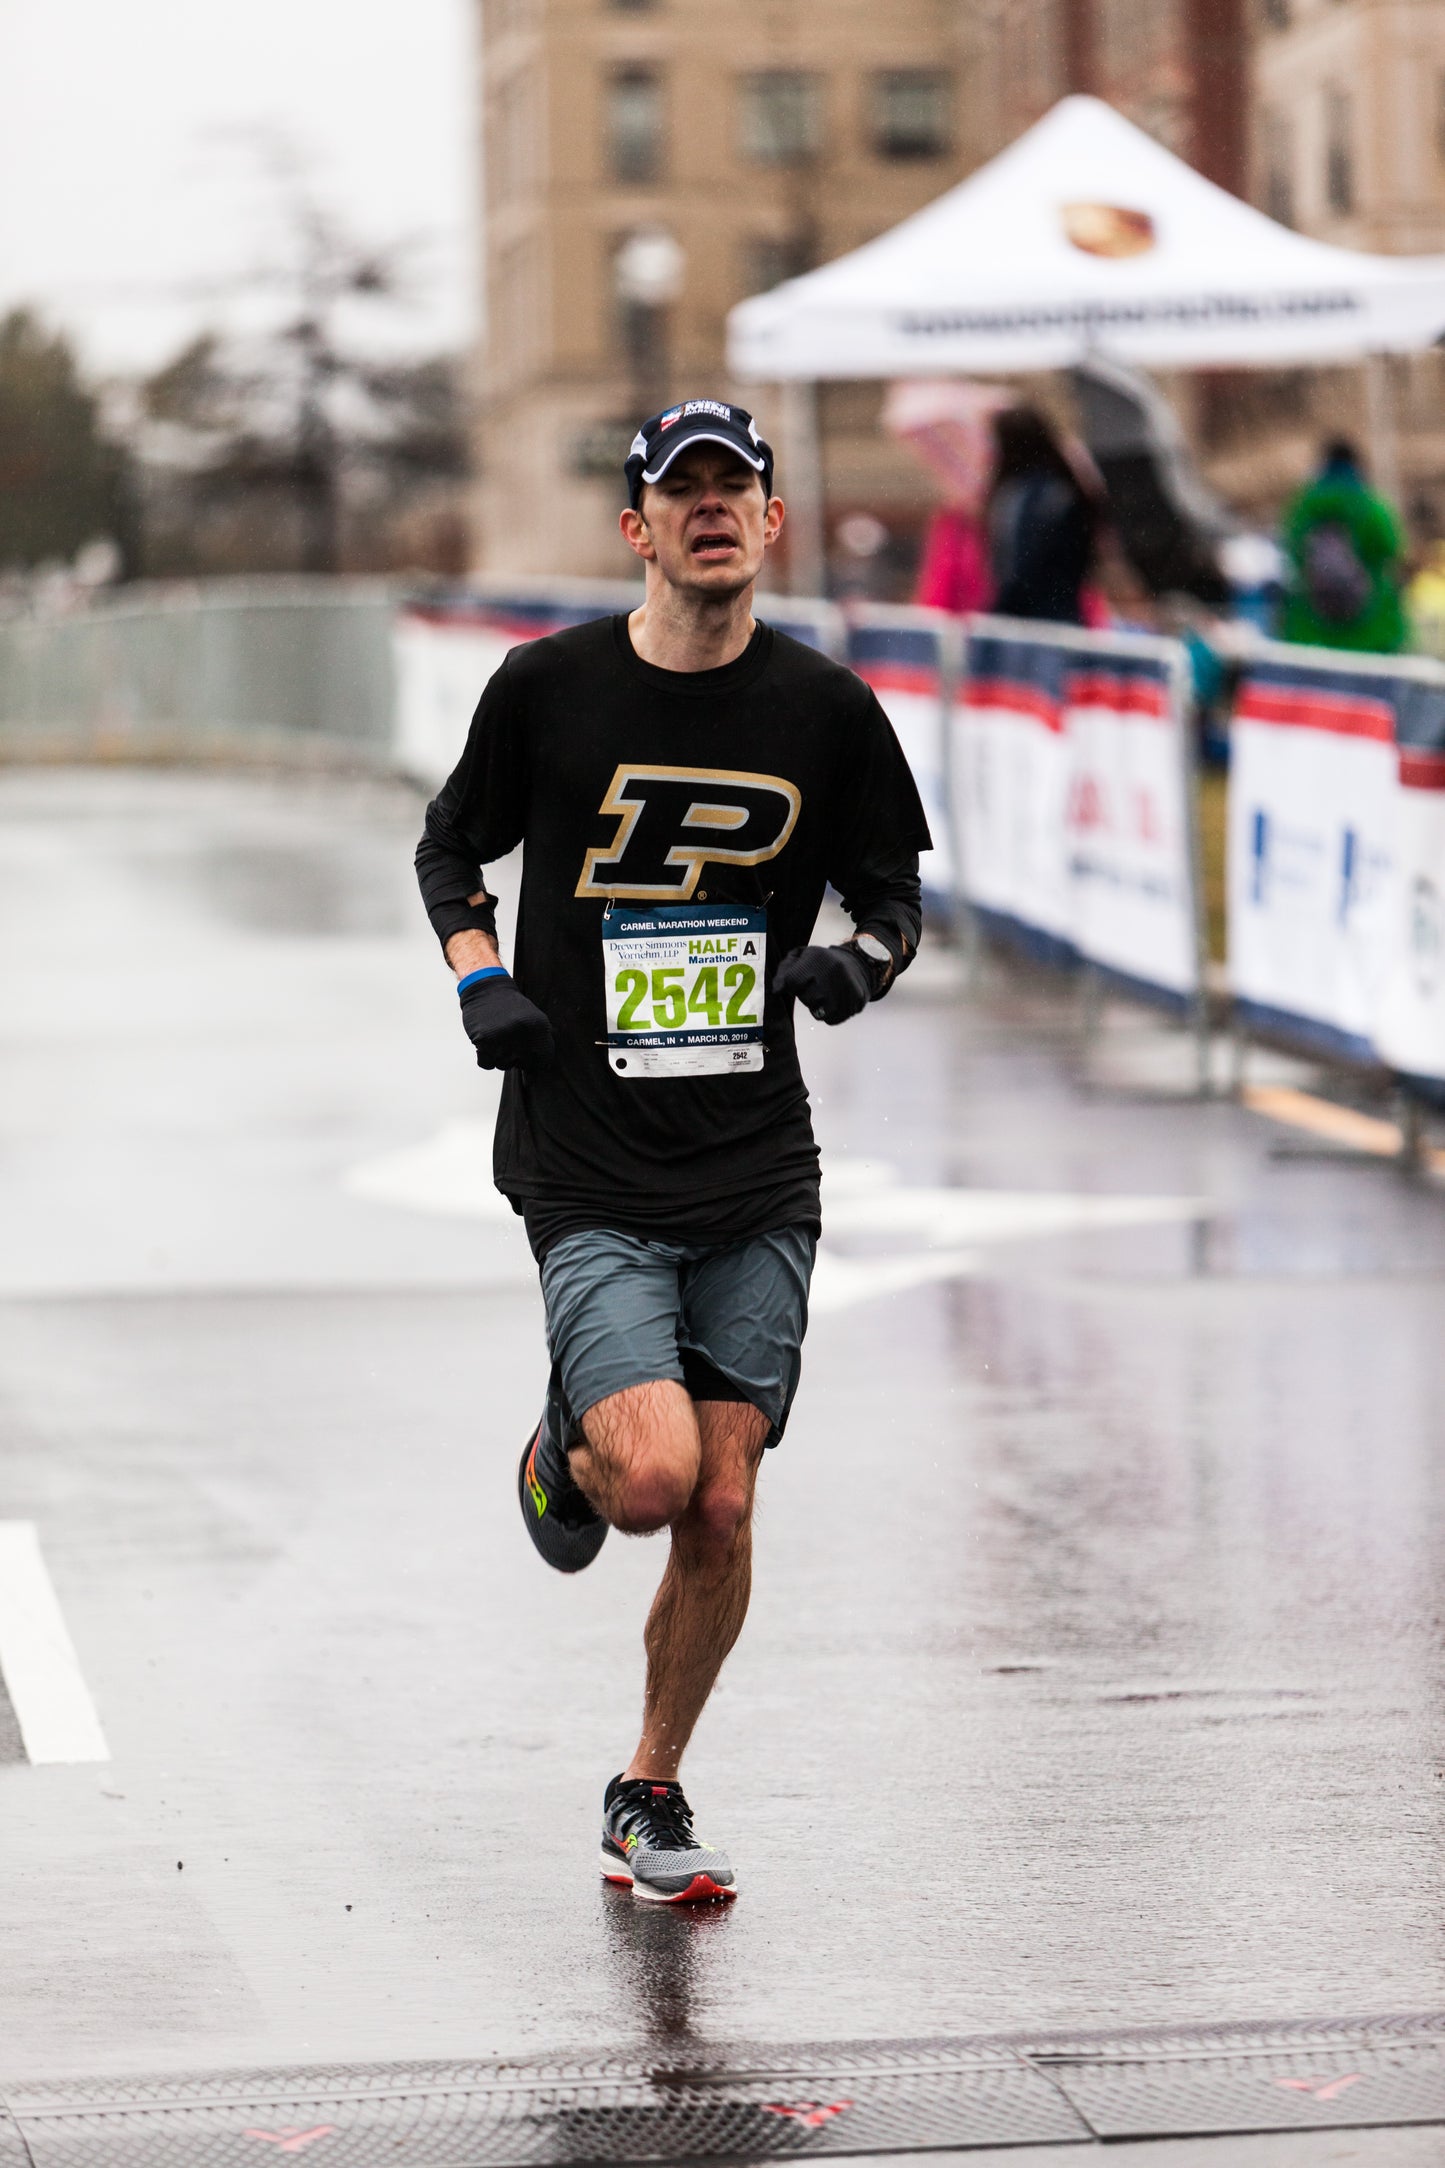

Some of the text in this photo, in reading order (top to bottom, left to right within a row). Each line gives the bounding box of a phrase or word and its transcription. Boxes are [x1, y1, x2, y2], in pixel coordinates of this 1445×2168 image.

[574, 764, 802, 900] P
[621, 918, 749, 931] CARMEL MARATHON WEEKEND
[610, 940, 687, 952] Drewry Simmons
[688, 938, 738, 954] HALF
[743, 941, 757, 955] A
[688, 954, 738, 964] Marathon
[615, 963, 758, 1030] 2542
[626, 1032, 748, 1046] CARMEL, IN MARCH 30, 2019
[733, 1052, 748, 1060] 2542
